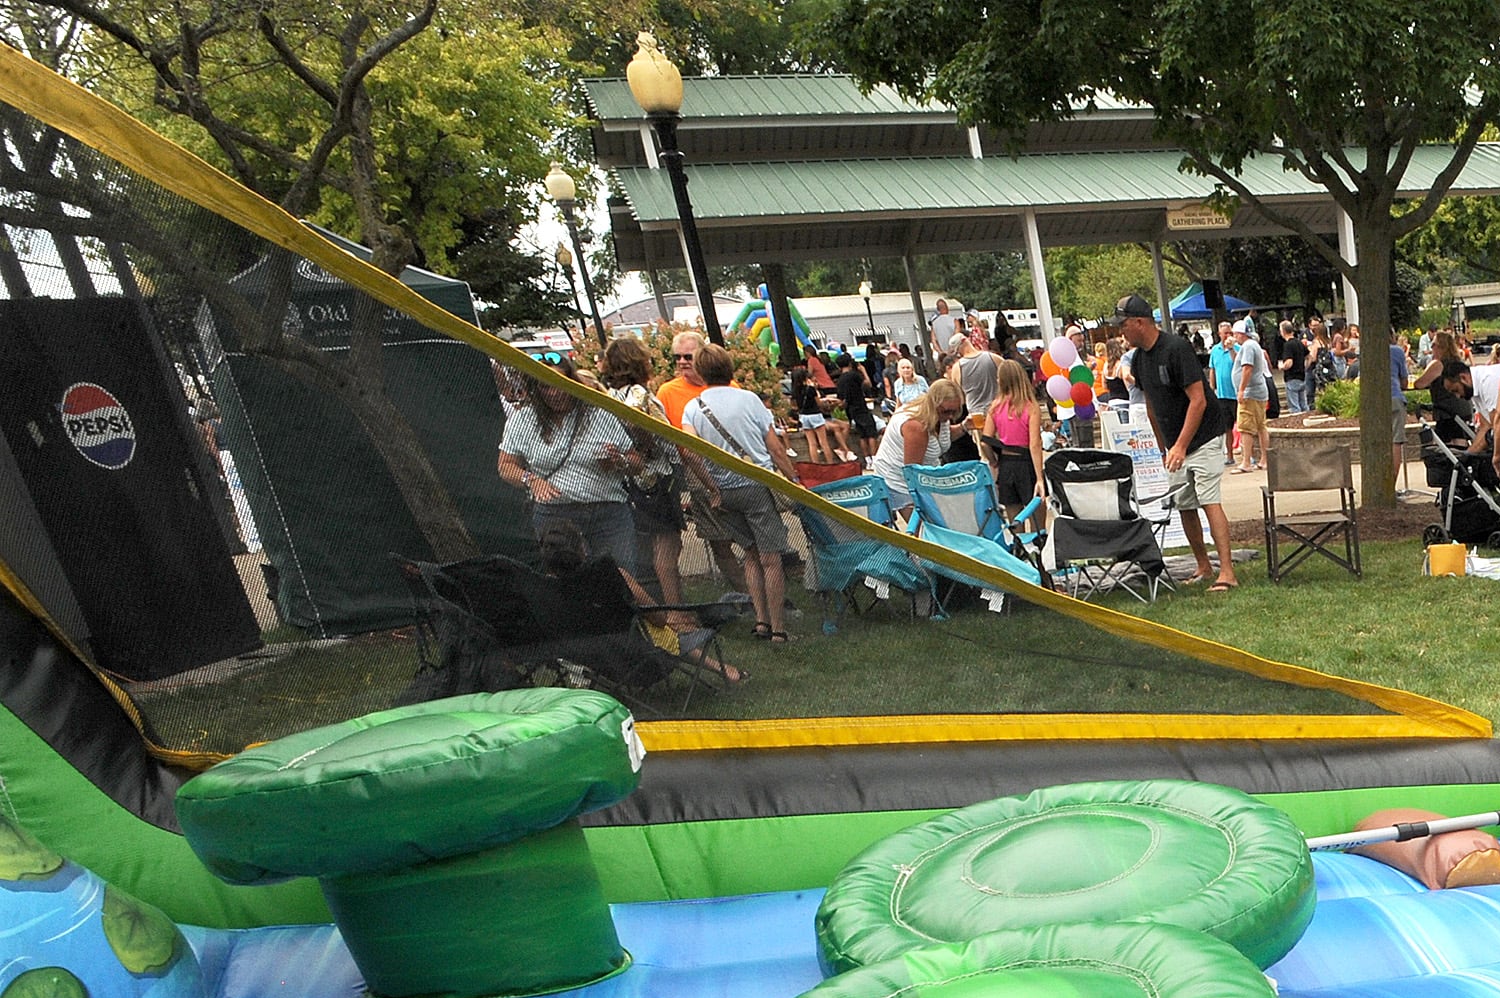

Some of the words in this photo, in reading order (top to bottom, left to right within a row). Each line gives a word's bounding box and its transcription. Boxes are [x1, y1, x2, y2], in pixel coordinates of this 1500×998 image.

[1172, 218, 1206, 226] GATHERING
[308, 303, 350, 323] Old
[67, 415, 131, 436] PEPSI
